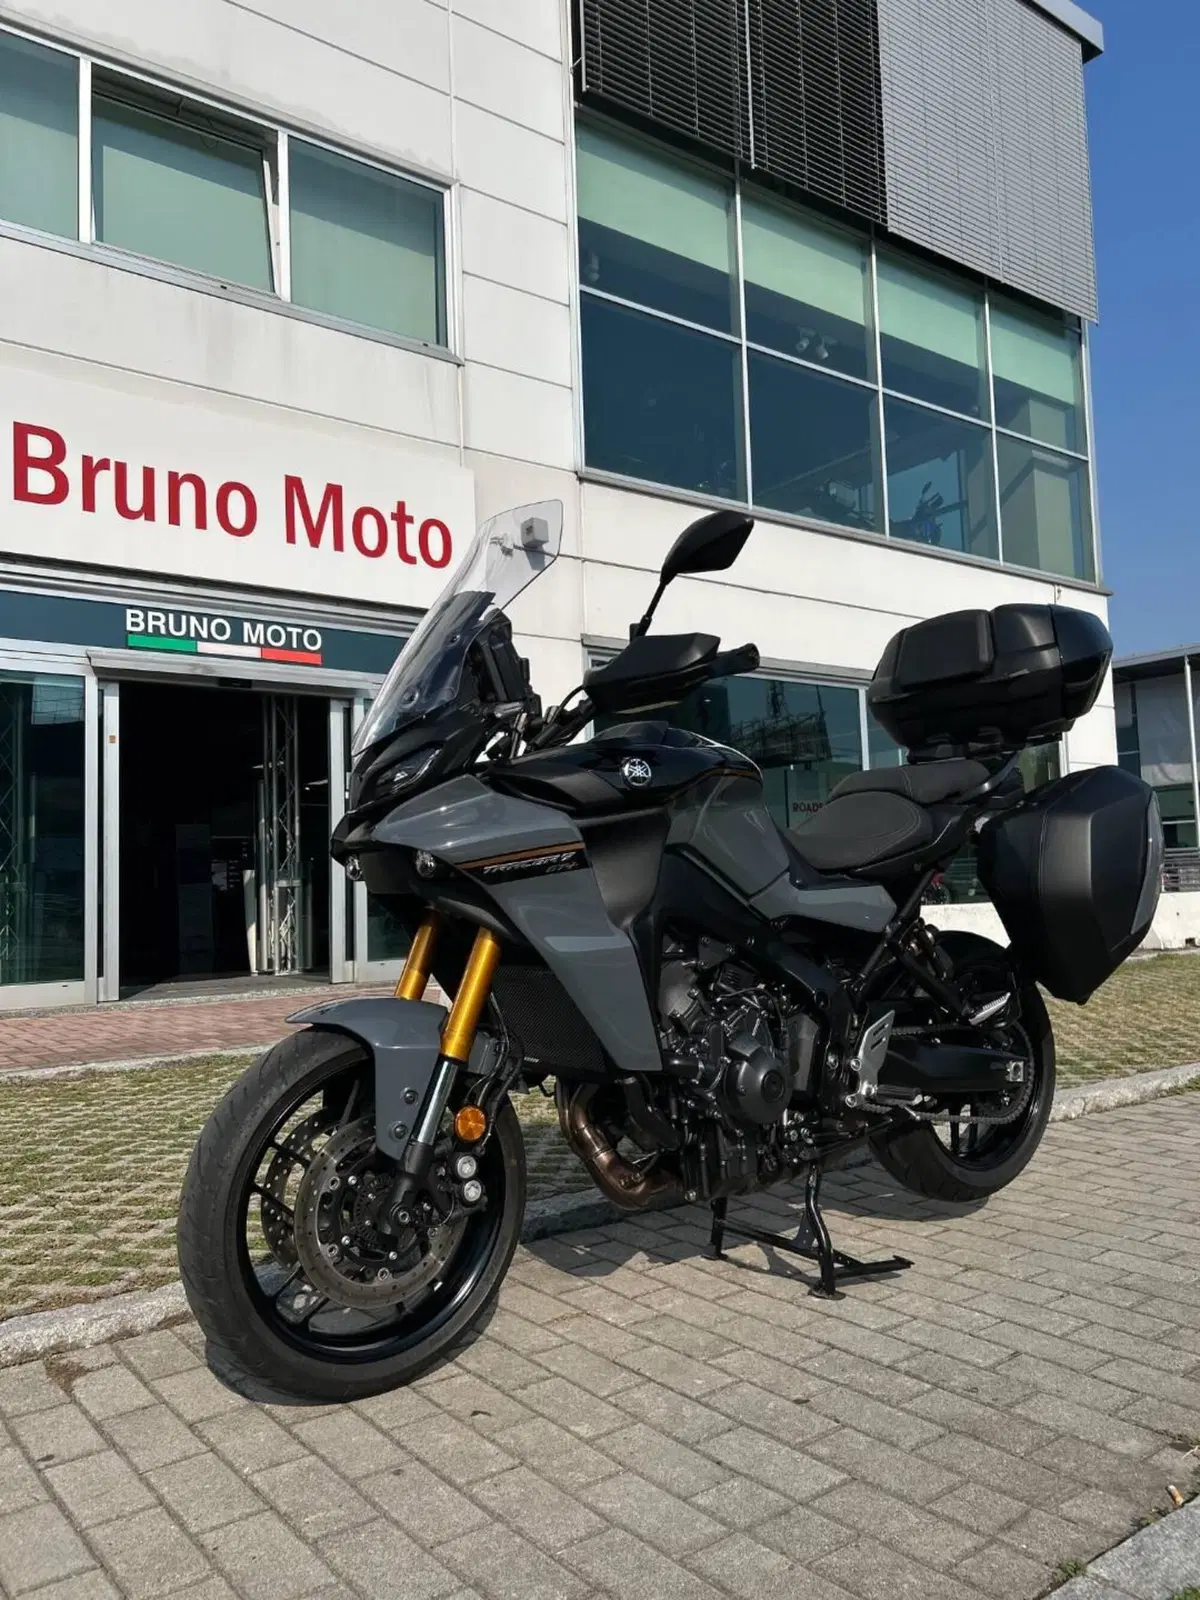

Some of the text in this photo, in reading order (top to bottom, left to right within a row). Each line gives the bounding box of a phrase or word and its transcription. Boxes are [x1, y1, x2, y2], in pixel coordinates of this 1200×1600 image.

[13, 421, 452, 569] Bruno Moto
[126, 608, 322, 651] BRUNO MOTO
